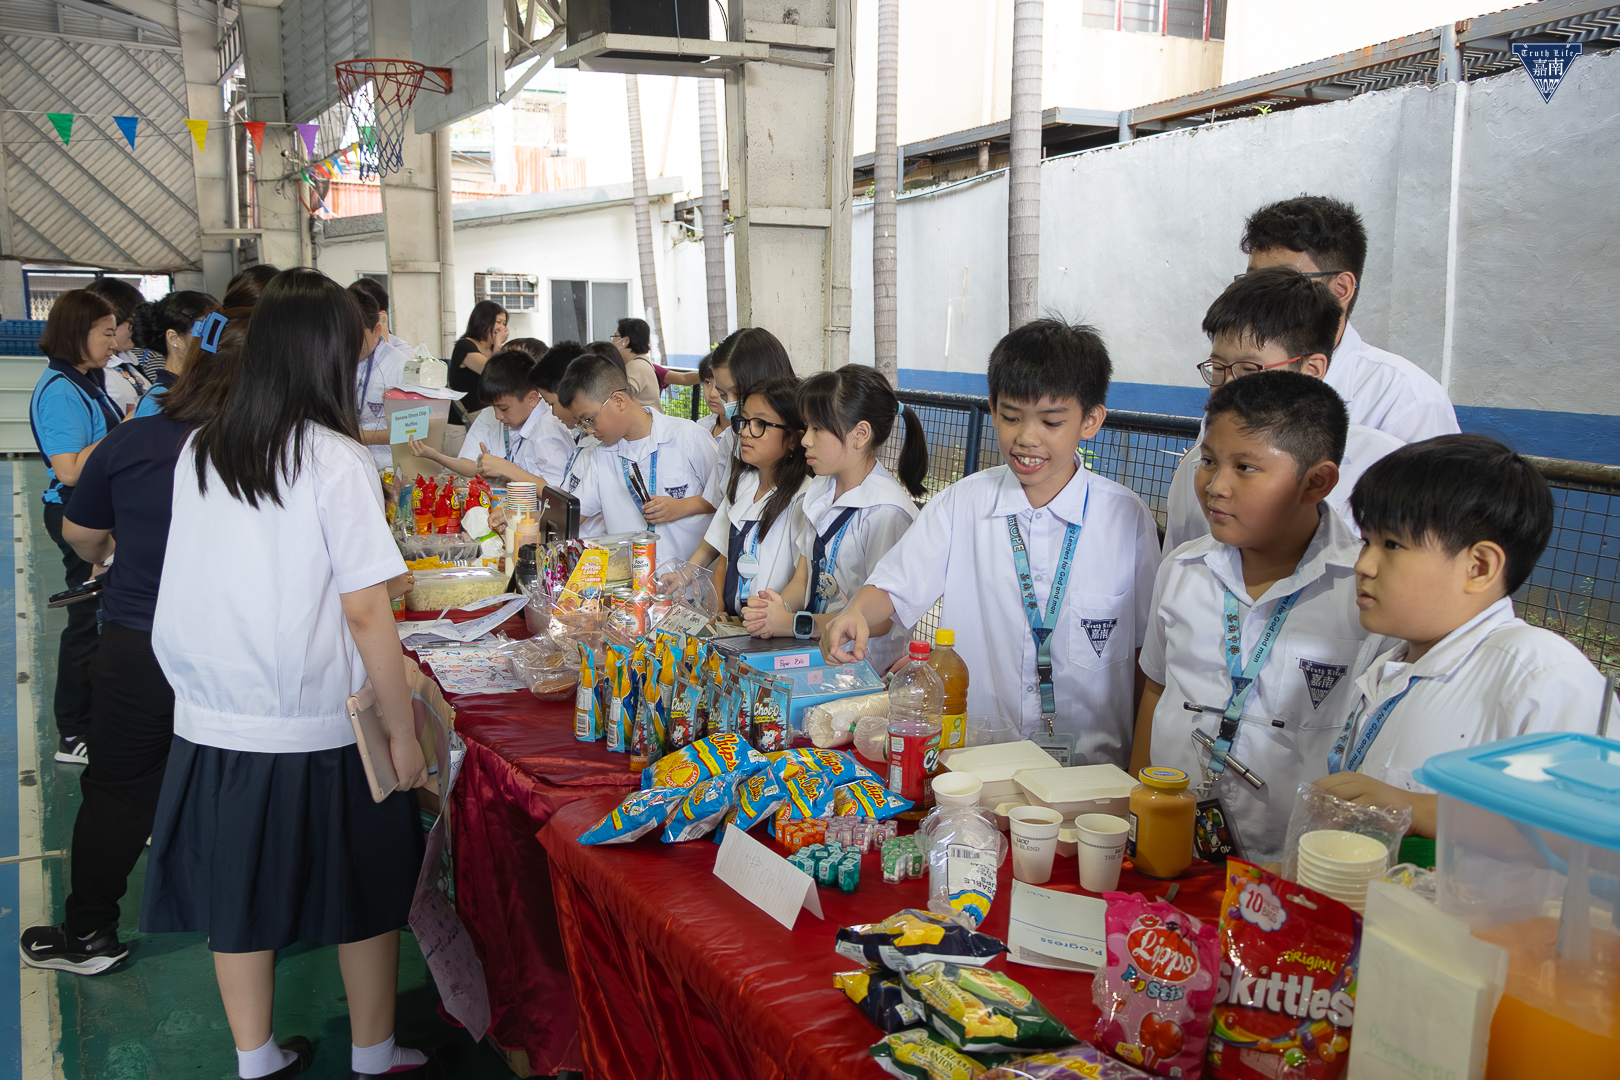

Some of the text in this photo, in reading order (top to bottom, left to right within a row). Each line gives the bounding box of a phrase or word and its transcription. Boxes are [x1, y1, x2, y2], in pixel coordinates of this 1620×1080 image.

[1063, 536, 1074, 560] Leaders
[1061, 559, 1070, 571] for
[1057, 572, 1066, 587] God
[1050, 599, 1058, 615] man
[1276, 606, 1286, 617] for
[1268, 616, 1281, 632] God
[1261, 632, 1271, 647] and
[1254, 647, 1264, 663] man
[1376, 713, 1384, 723] for
[1366, 722, 1378, 740] God
[711, 733, 739, 772] Chips
[1357, 739, 1367, 755] and
[1347, 753, 1358, 770] man
[860, 779, 887, 808] Chips
[1245, 889, 1264, 913] 10
[1261, 906, 1278, 924] BAGS
[1040, 937, 1103, 956] Progress
[1132, 930, 1194, 975] Lipps
[1121, 964, 1146, 993] Pop
[1213, 962, 1354, 1028] Skittles
[918, 1036, 940, 1054] SOUR
[940, 1048, 971, 1072] CREAM
[929, 1051, 954, 1072] ONION
